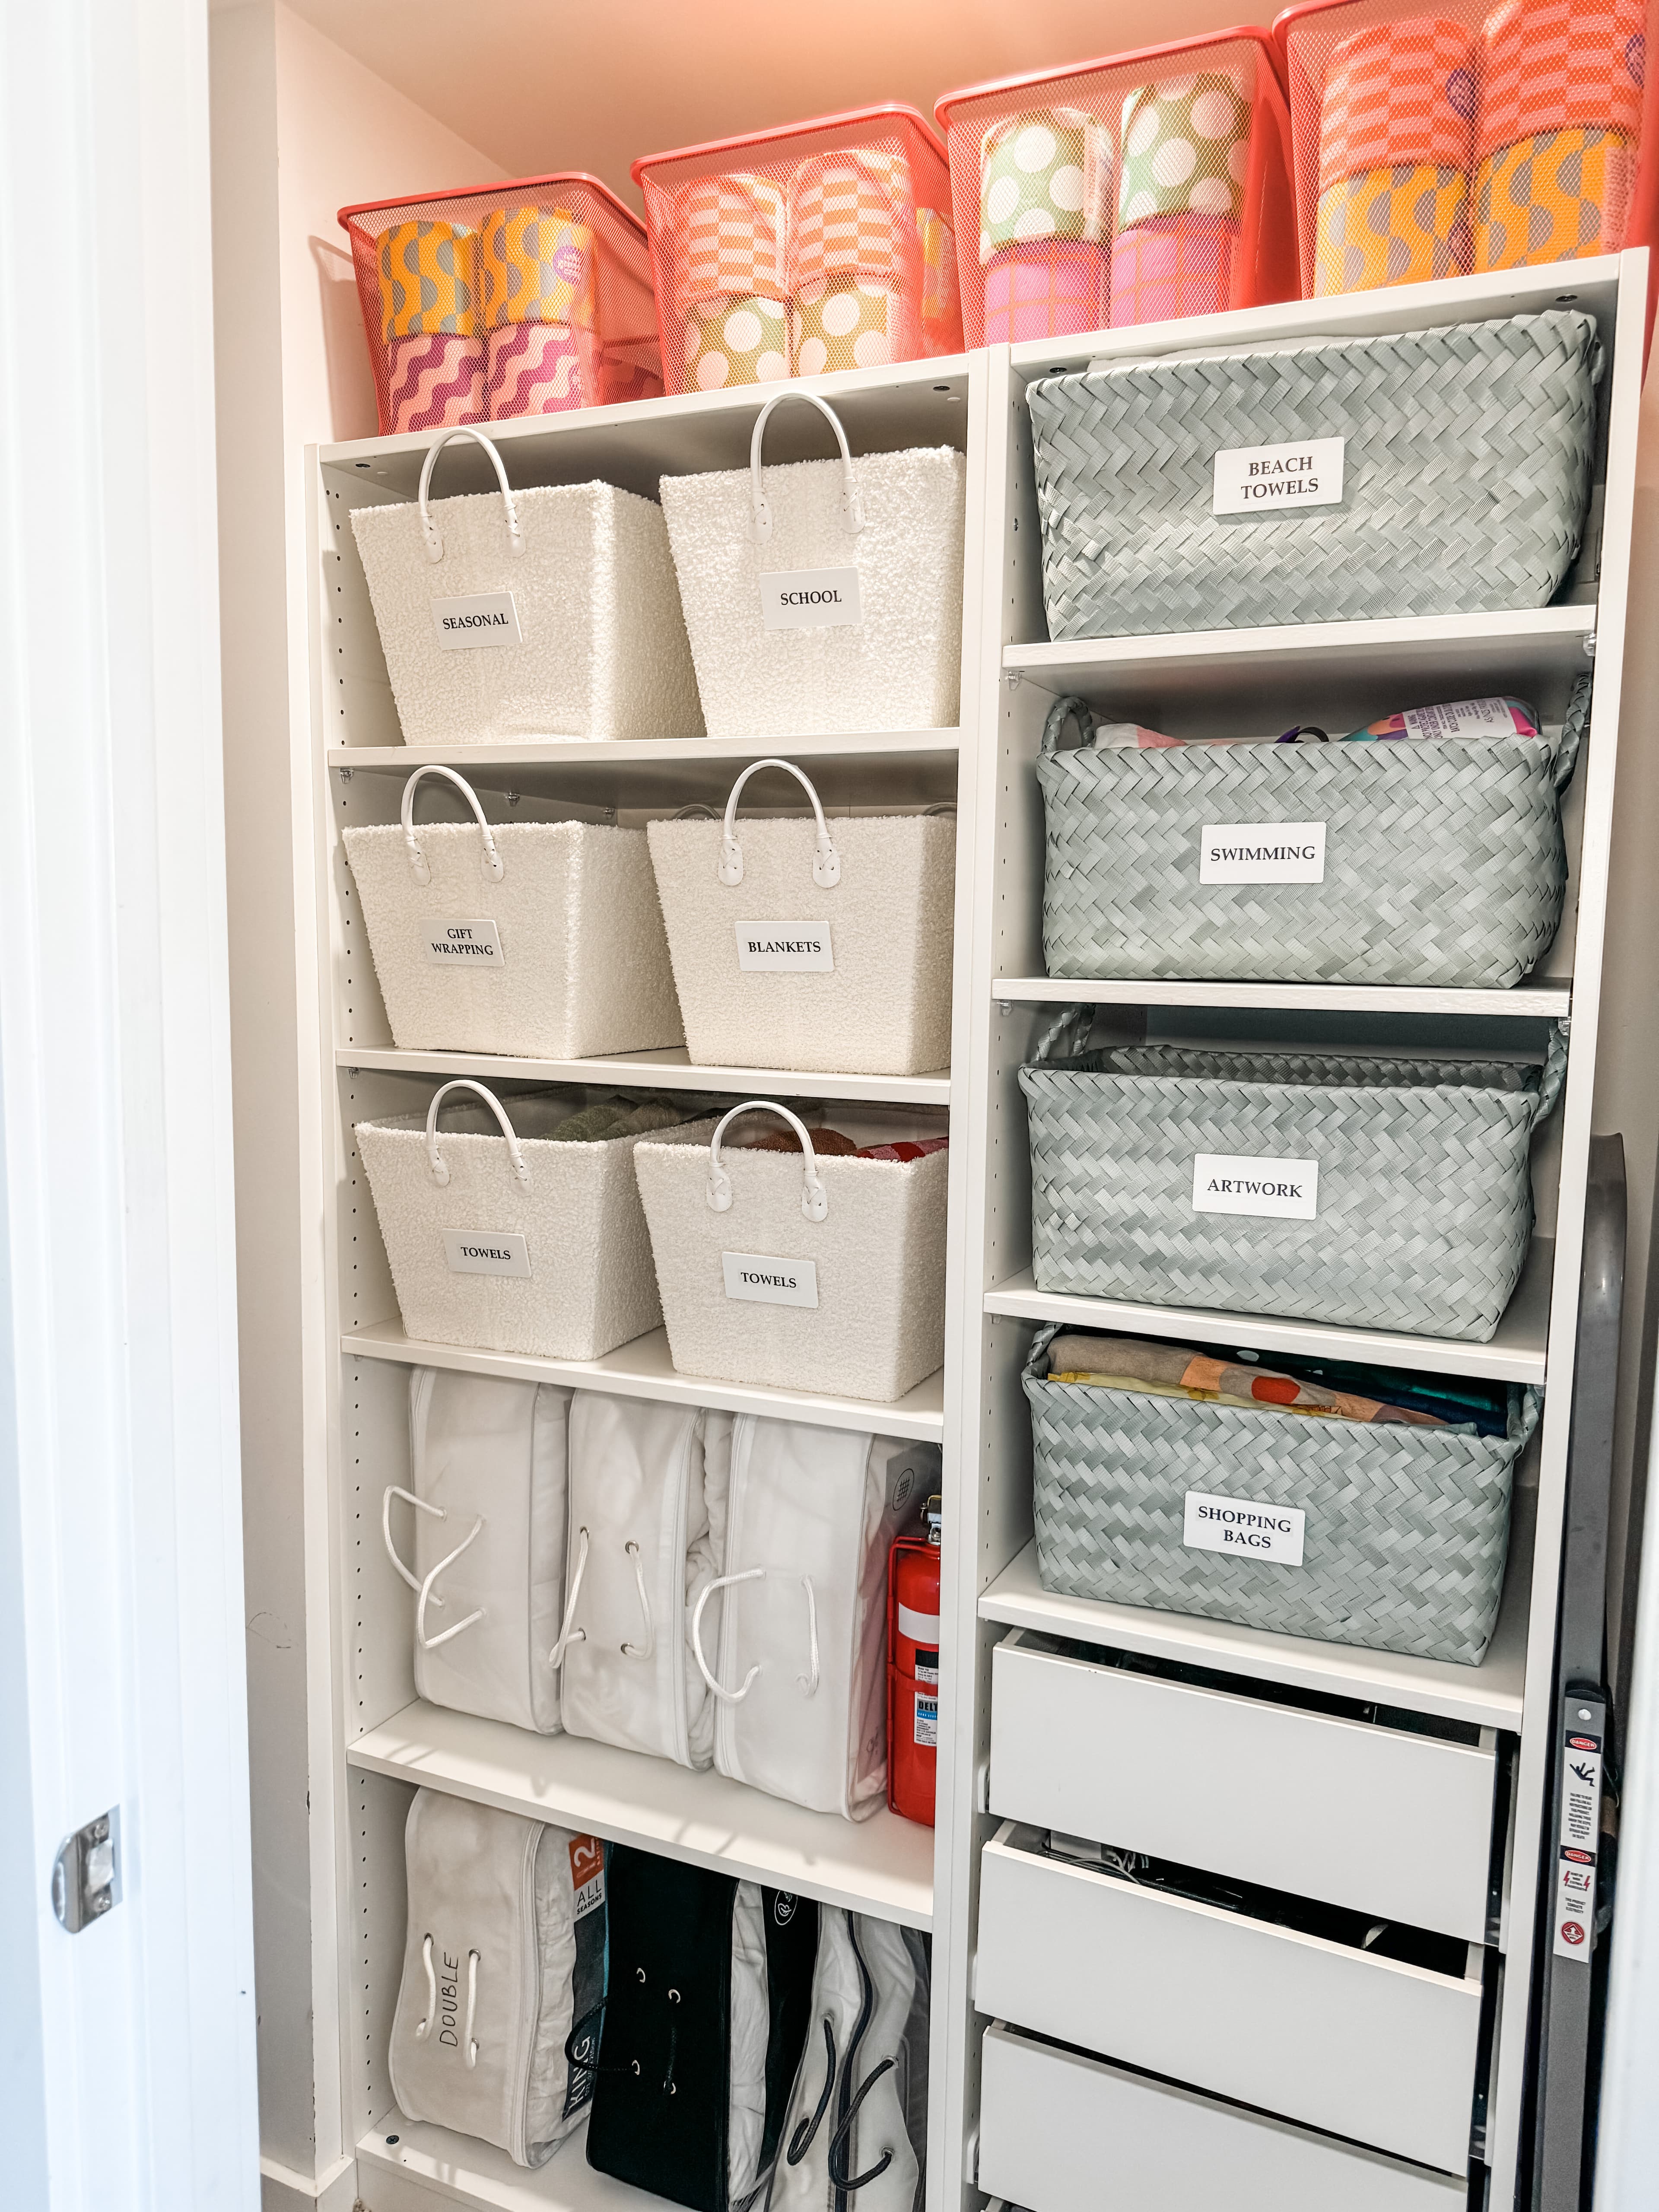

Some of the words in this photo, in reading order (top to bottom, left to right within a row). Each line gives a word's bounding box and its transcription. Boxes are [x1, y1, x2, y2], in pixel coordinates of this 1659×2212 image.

[1248, 456, 1313, 477] BEACH
[1241, 478, 1318, 499] TOWELS
[781, 590, 842, 605] SCHOOL
[442, 613, 509, 629] SEASONAL
[1211, 846, 1315, 861] SWIMMING
[447, 928, 473, 939] GIFT
[431, 943, 493, 955] WRAPPING
[747, 941, 821, 952] BLANKETS
[1207, 1179, 1303, 1198] ARTWORK
[460, 1247, 511, 1260] TOWELS
[741, 1272, 797, 1288] TOWELS
[1198, 1506, 1291, 1532] SHOPPING
[1223, 1529, 1271, 1548] BAGS
[1566, 1852, 1589, 1860] DANGER
[577, 1880, 602, 1907] ALL
[577, 1892, 602, 1915] SEASONS
[439, 1951, 458, 2047] DOUBLE
[568, 2036, 591, 2109] KING
